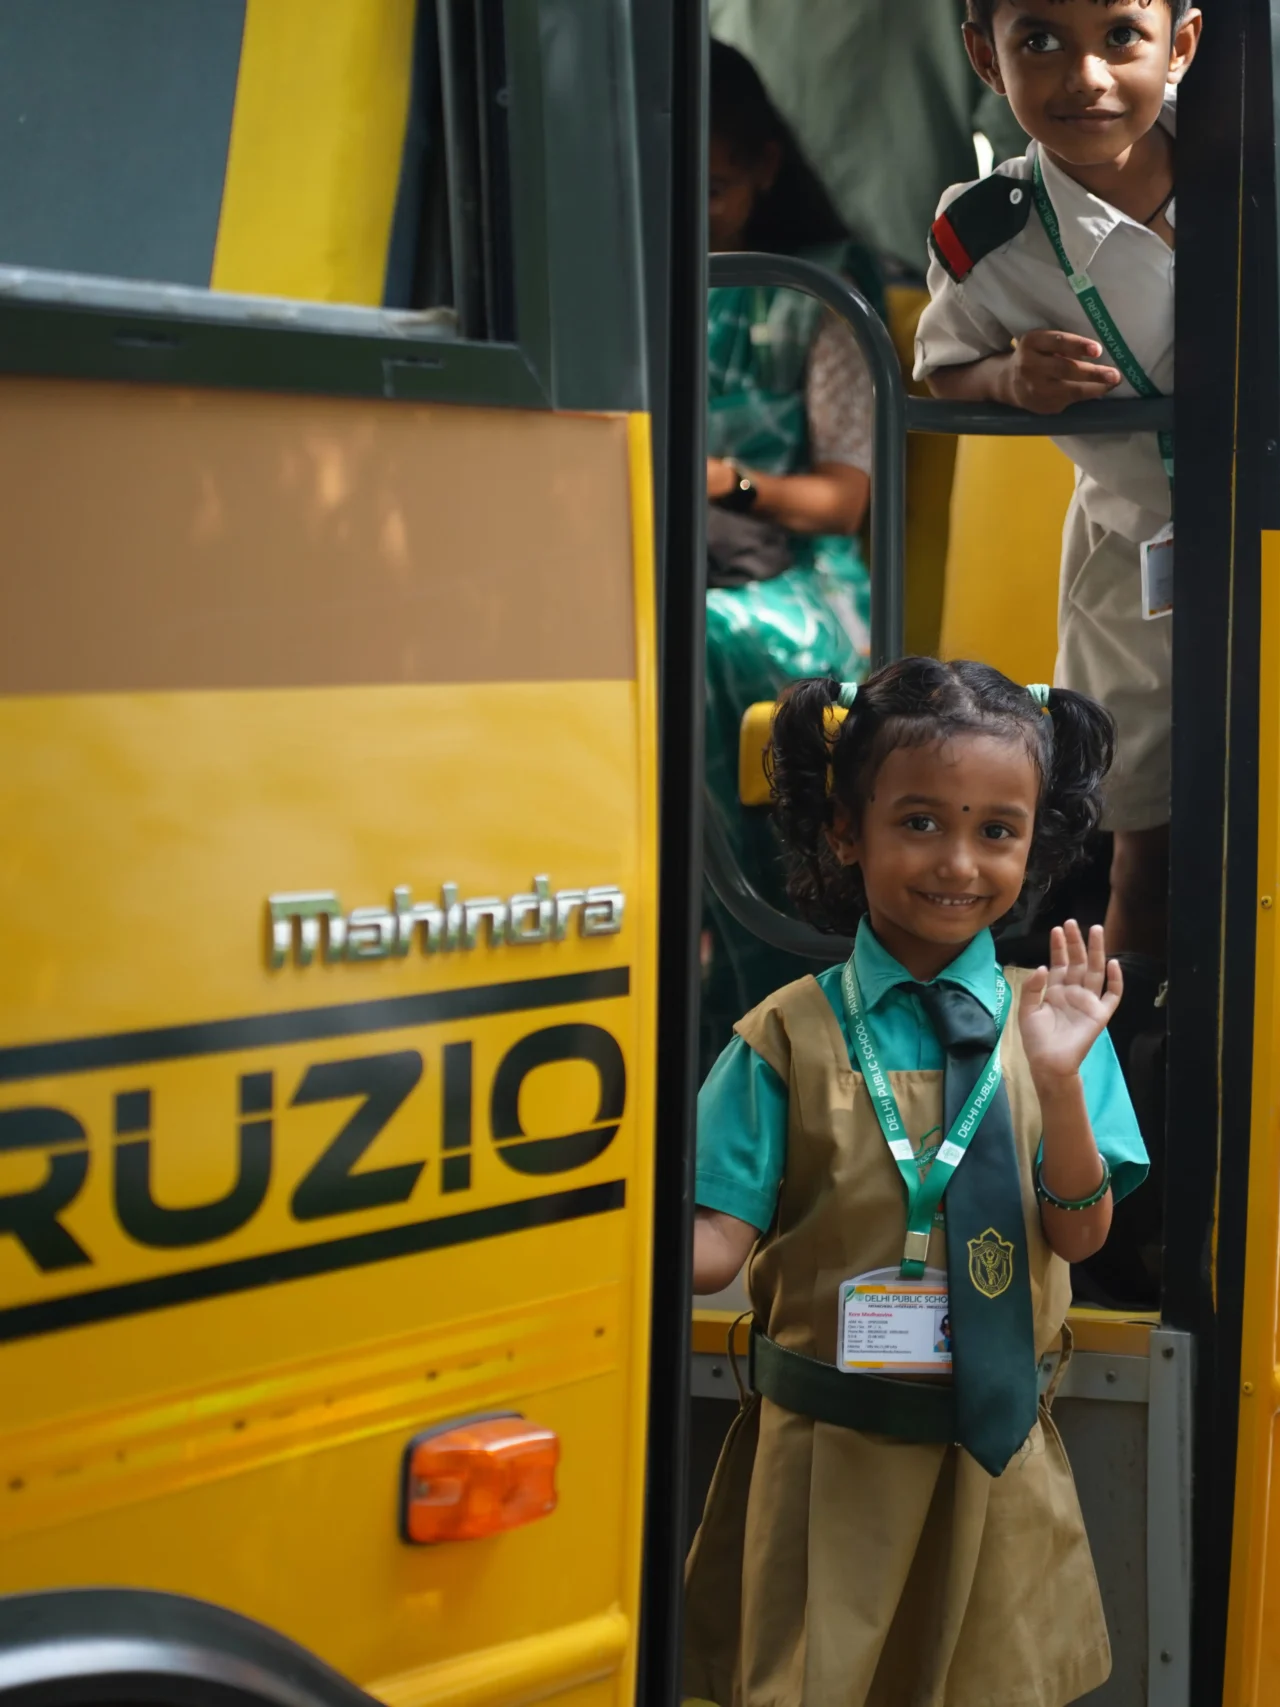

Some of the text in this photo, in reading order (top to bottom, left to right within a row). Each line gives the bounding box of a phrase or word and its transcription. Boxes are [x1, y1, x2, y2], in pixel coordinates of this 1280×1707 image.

[1085, 297, 1124, 360] PATANCHERU
[266, 873, 625, 970] Mahindra
[854, 1019, 878, 1061] SCHOOL
[868, 1060, 889, 1098] PUBLIC
[880, 1099, 900, 1132] DELHI
[957, 1107, 979, 1139] DELHI
[974, 1071, 997, 1109] PUBLIC
[865, 1295, 949, 1303] DELHI PUBLIC SCHO
